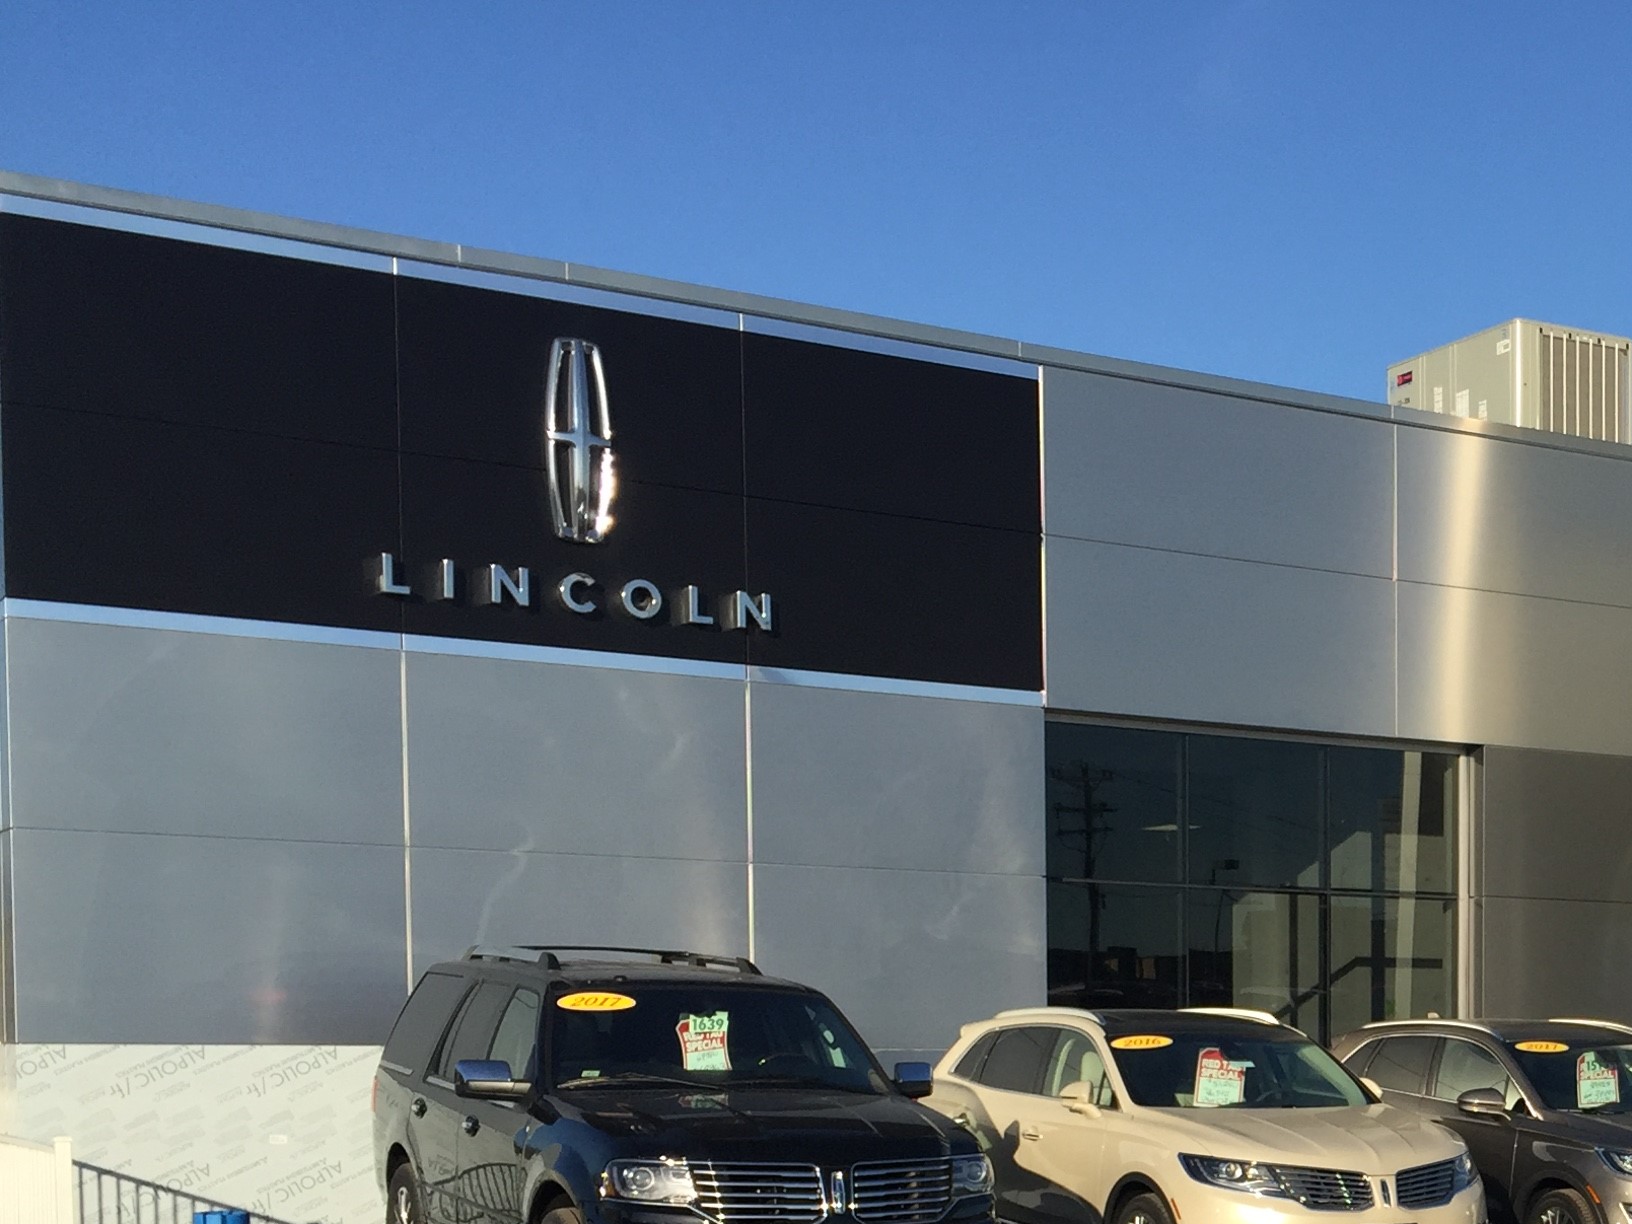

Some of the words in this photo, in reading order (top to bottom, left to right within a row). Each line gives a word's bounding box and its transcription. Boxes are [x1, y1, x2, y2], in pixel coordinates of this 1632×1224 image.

[377, 551, 773, 632] LINCOLN
[570, 996, 622, 1007] 2017
[692, 1018, 725, 1031] 1639
[685, 1038, 724, 1052] SPECIAL
